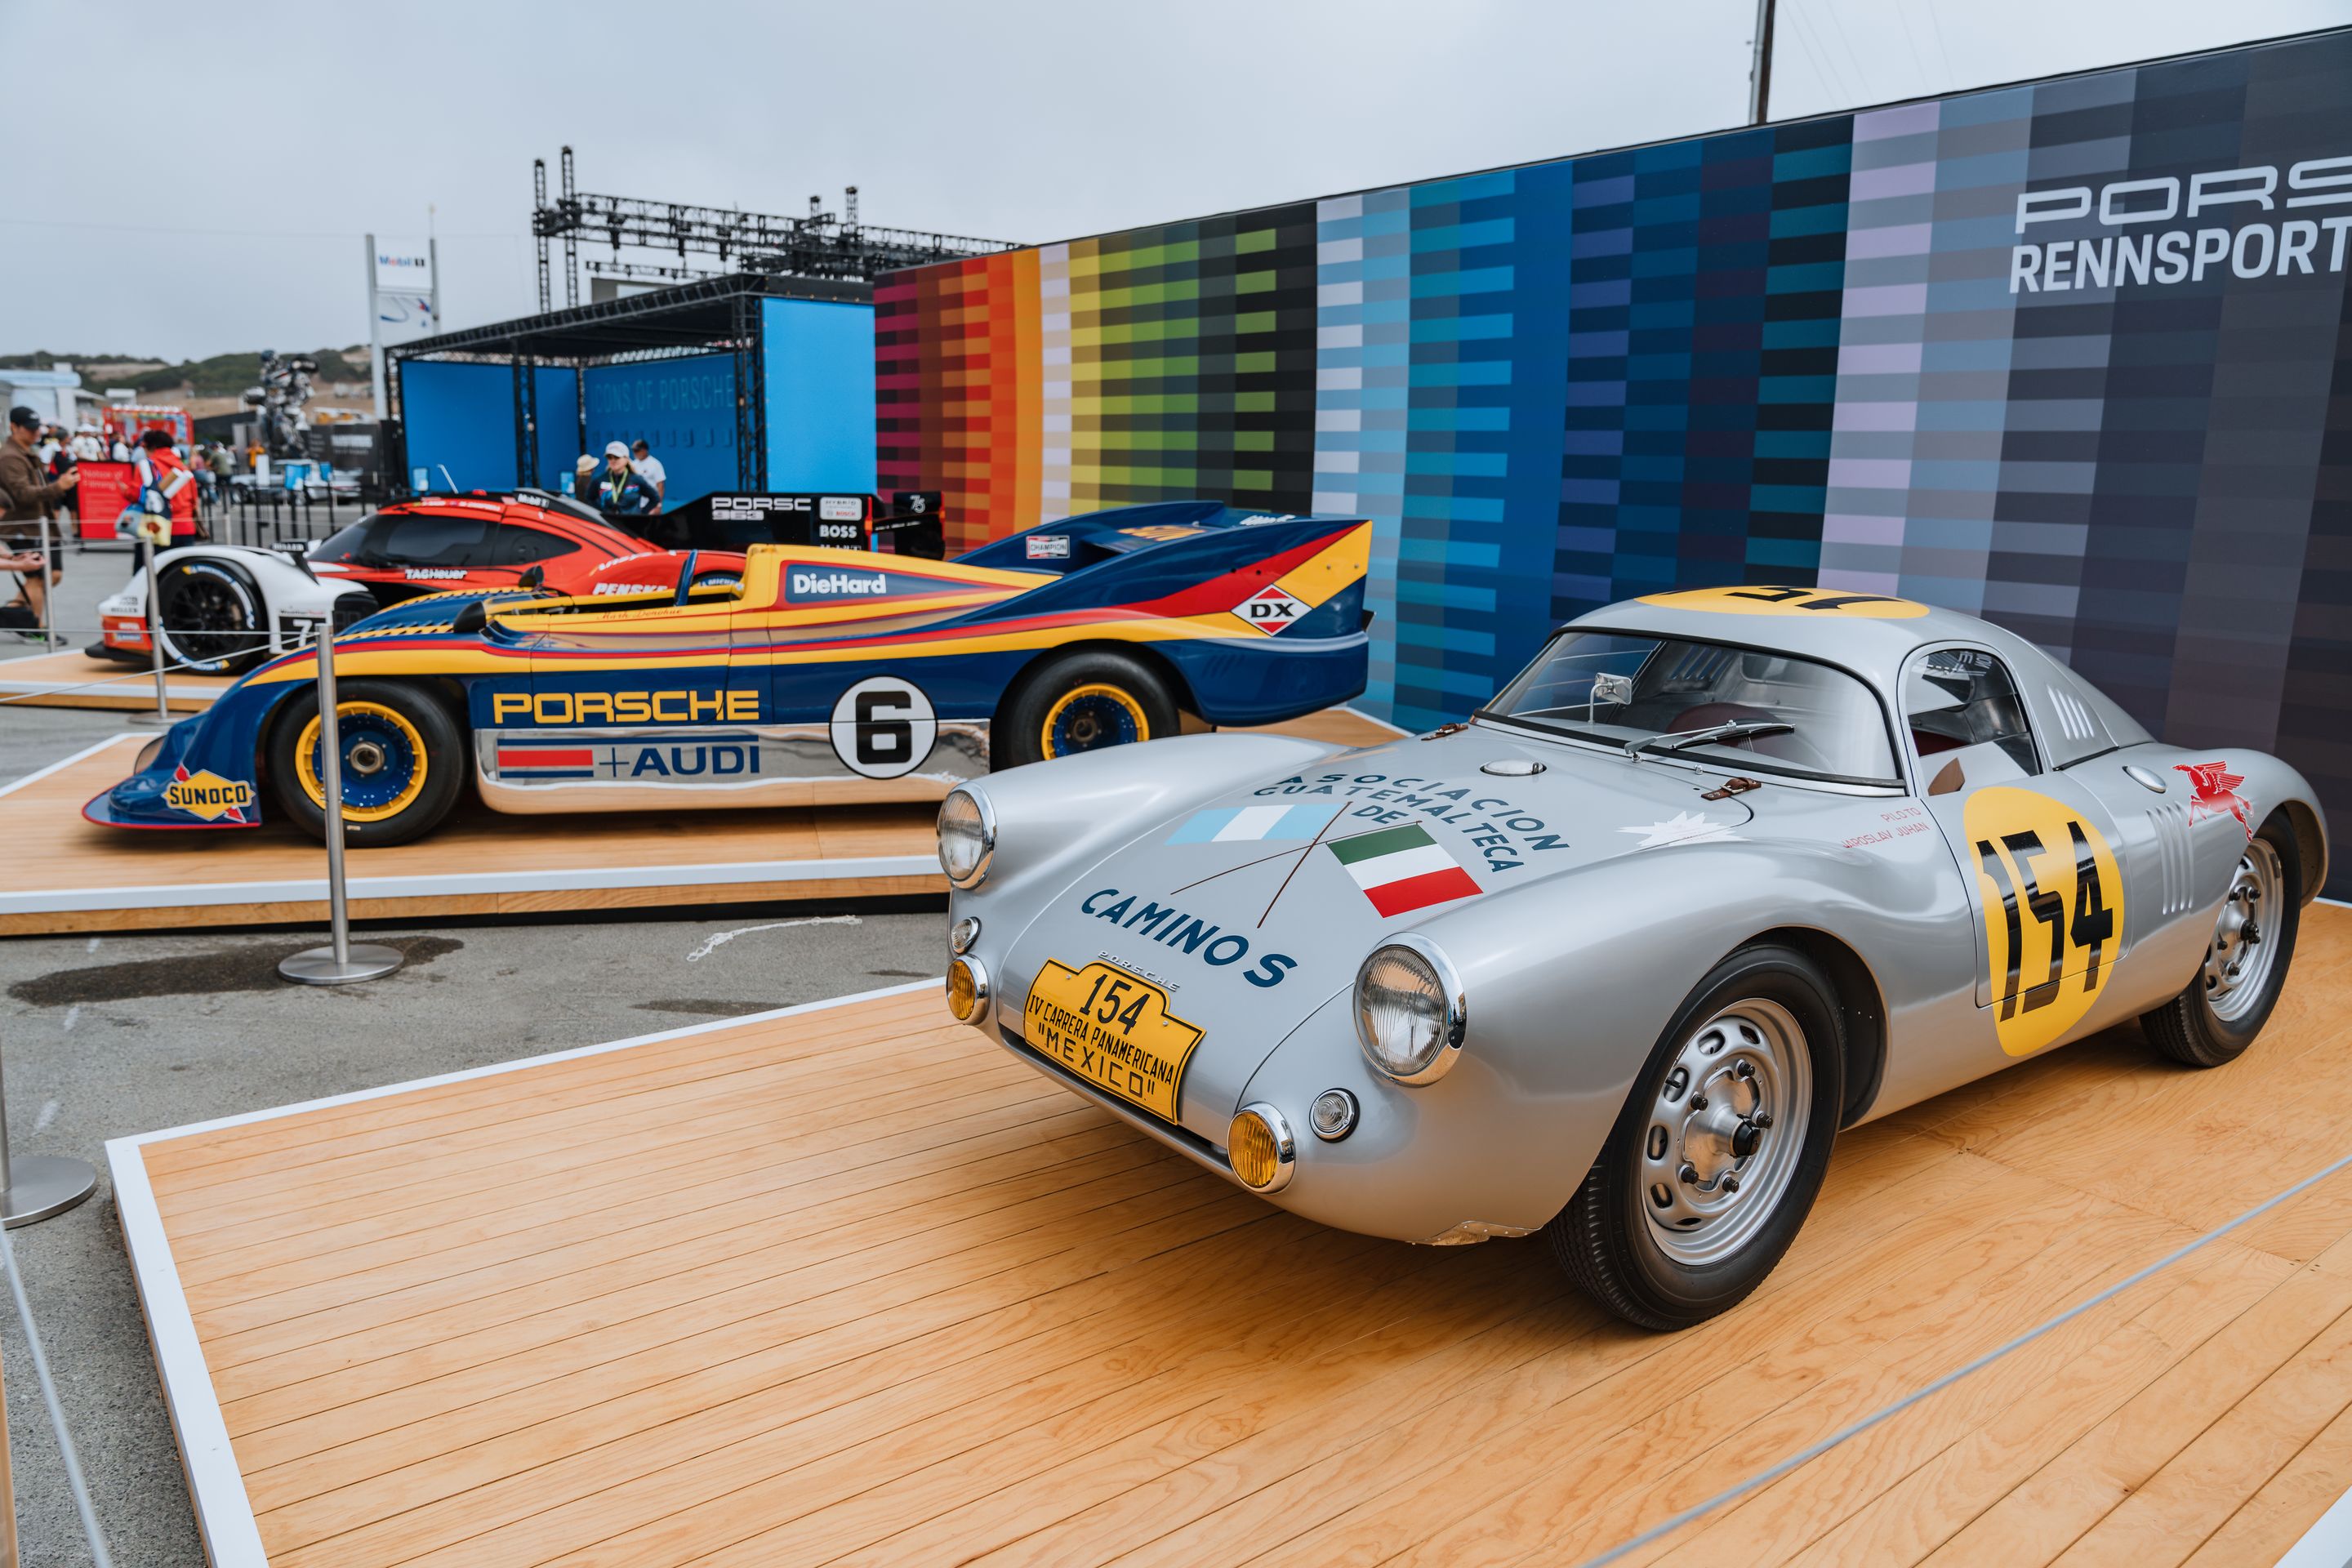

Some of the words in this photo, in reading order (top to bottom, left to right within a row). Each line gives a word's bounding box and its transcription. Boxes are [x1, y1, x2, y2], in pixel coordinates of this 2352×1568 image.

[2010, 216, 2352, 294] RENNSPORT
[635, 379, 654, 412] OF
[659, 374, 735, 411] PORSCHE
[711, 510, 764, 521] 963
[910, 494, 926, 514] 75
[819, 524, 858, 538] BOSS
[1030, 542, 1067, 552] CHAMPION
[793, 573, 887, 595] DieHard
[1250, 603, 1295, 618] DX
[292, 618, 313, 648] 7
[492, 690, 760, 724] PORSCHE
[855, 690, 914, 765] 6
[169, 785, 247, 805] SUNOCO
[1276, 773, 1570, 852] ASOCIACION
[1352, 804, 1410, 825] DE
[1880, 807, 1922, 822] PILOTO
[1842, 830, 1894, 849] JAROSLAV
[1895, 822, 1931, 836] JUHAN
[1976, 821, 2114, 1022] 154
[1081, 889, 1298, 988] CAMINOS
[1098, 950, 1181, 992] PORSCHE
[1079, 973, 1151, 1036] 154
[1028, 994, 1045, 1017] IV
[1043, 1002, 1089, 1039] CARRERA
[1089, 1027, 1175, 1085] PANAMERICANA
